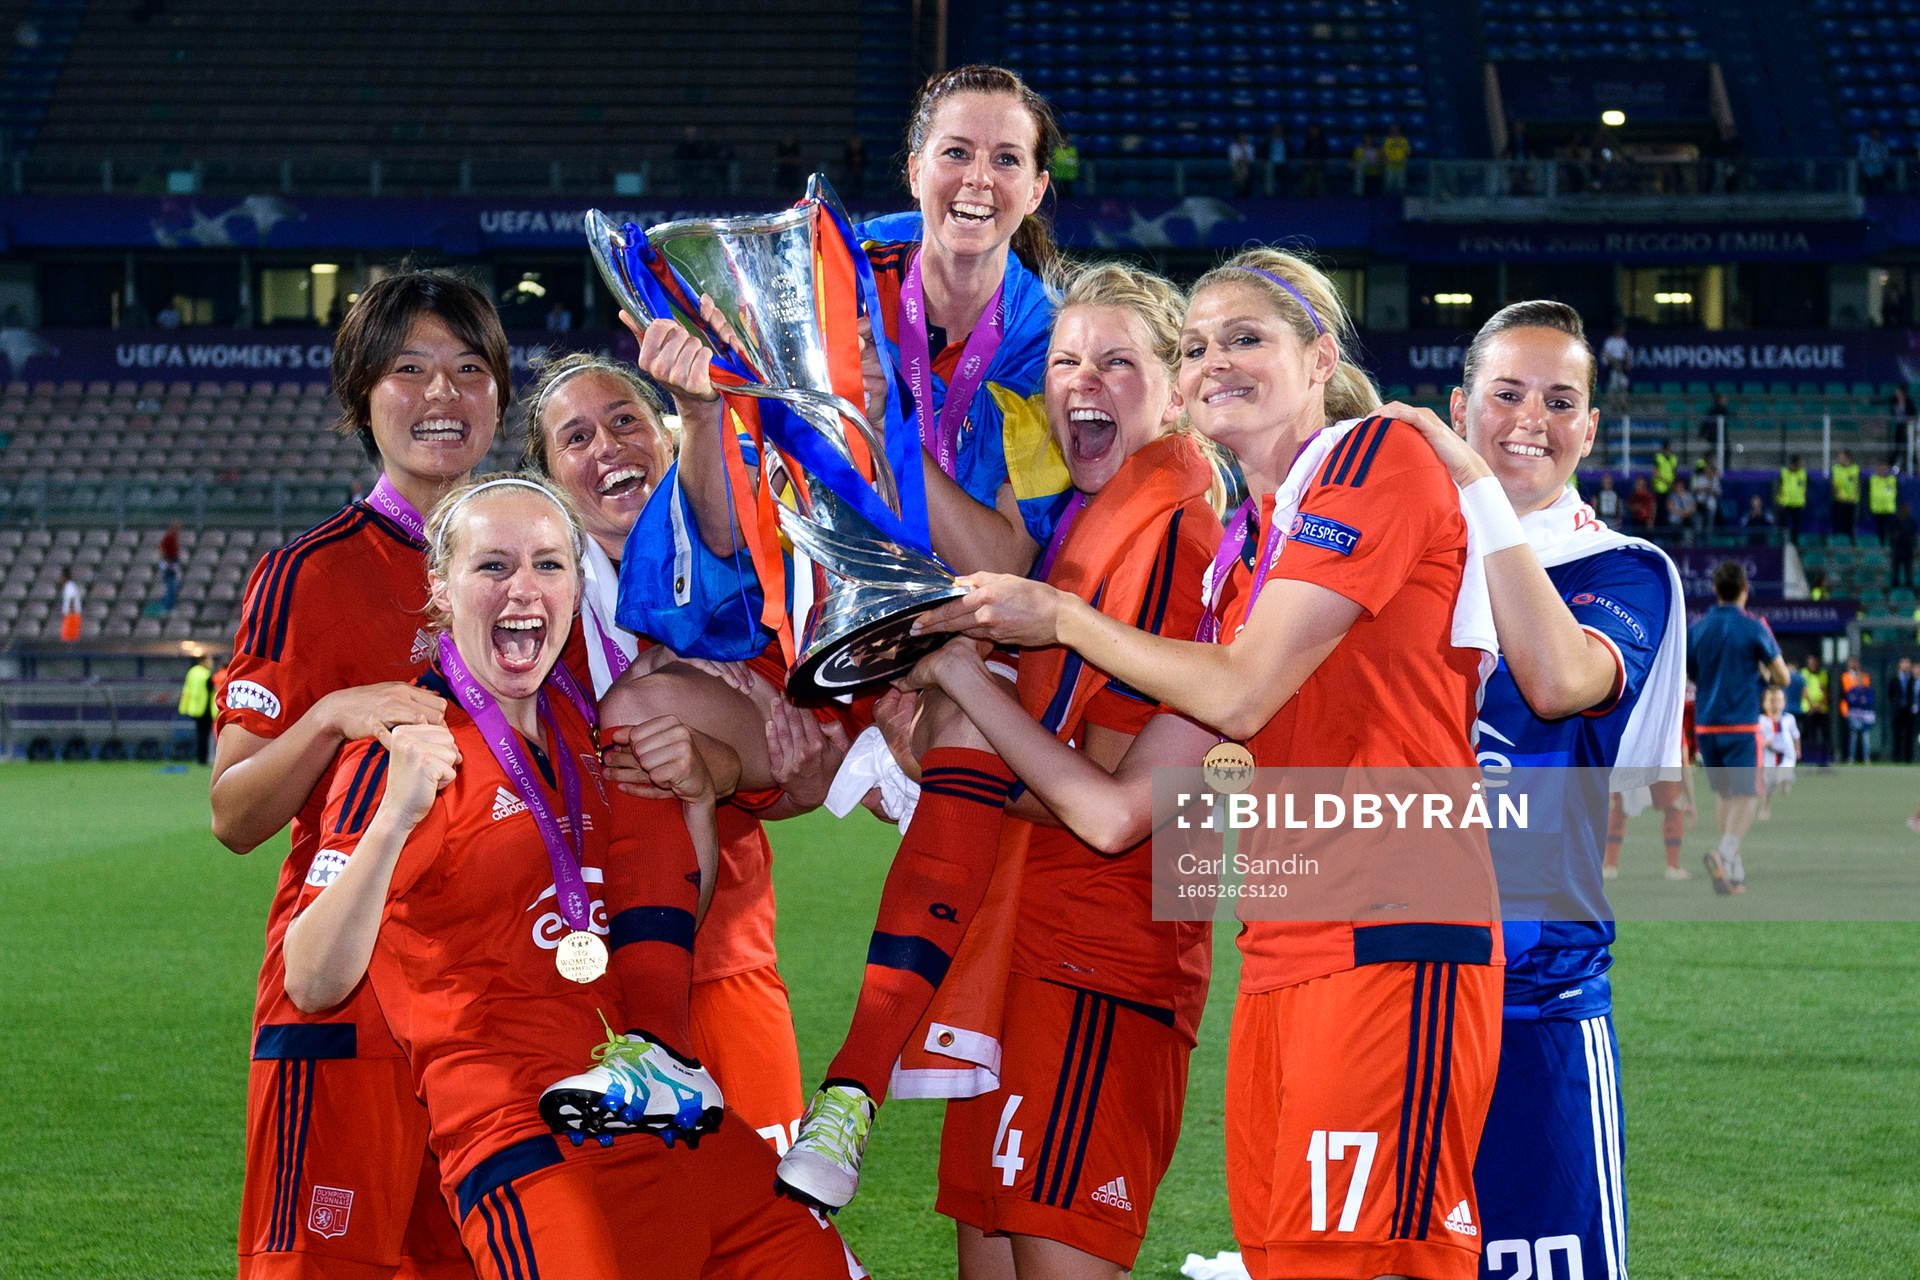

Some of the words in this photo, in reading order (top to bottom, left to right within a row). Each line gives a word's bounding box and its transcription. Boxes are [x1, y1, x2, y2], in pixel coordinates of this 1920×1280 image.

[480, 210, 548, 233] UEFA
[1604, 232, 1712, 252] REGGIO
[1718, 231, 1810, 251] EMILIA
[116, 344, 185, 368] UEFA
[187, 344, 303, 368] WOMEN'S
[1633, 345, 1744, 368] AMPIONS
[1750, 345, 1845, 368] LEAGUE
[376, 486, 401, 517] EGGIO
[400, 513, 424, 535] EMIL
[1302, 522, 1357, 547] RESPECT
[1595, 597, 1645, 640] RESPECT
[499, 737, 524, 775] EMILIA
[1306, 1130, 1378, 1232] 17
[1091, 1190, 1132, 1211] adidas
[1444, 1220, 1478, 1237] adidas
